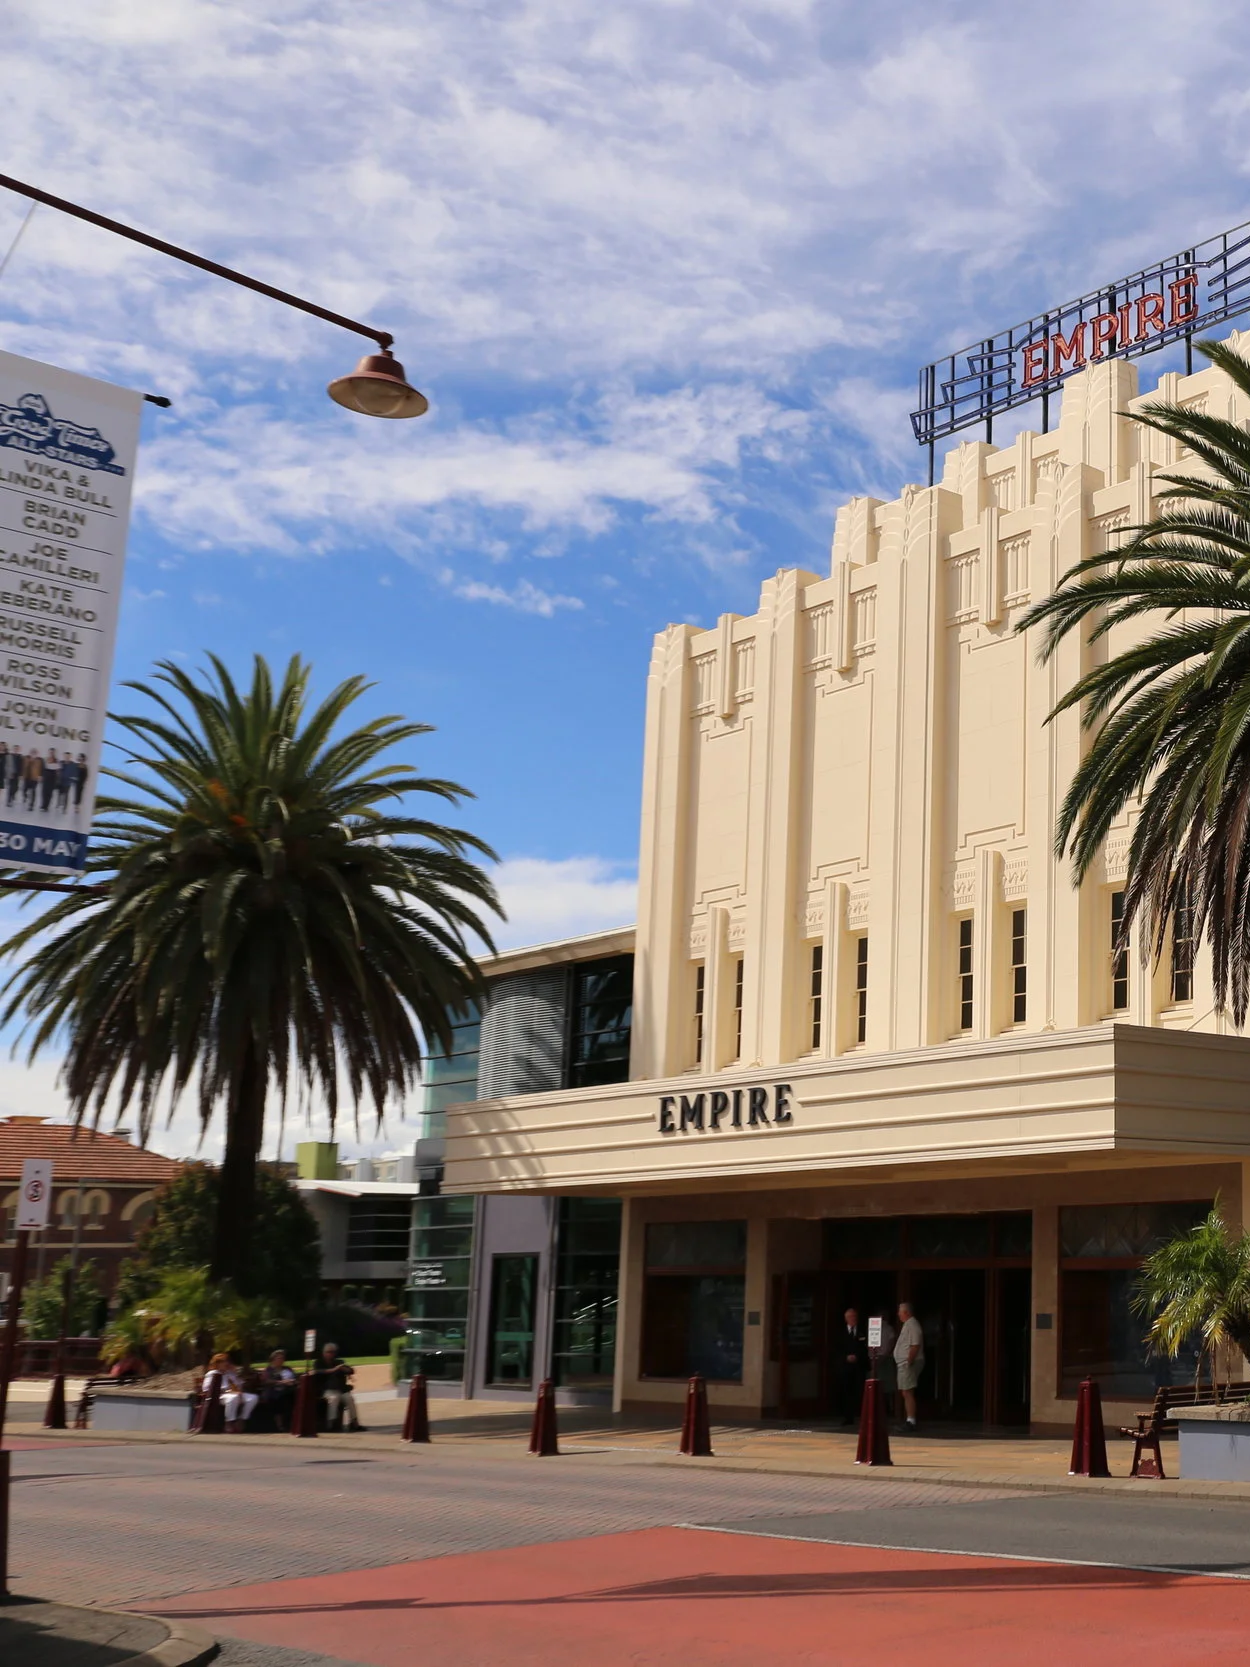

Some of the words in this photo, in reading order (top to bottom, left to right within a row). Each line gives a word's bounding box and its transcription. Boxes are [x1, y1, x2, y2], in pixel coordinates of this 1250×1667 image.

[1021, 273, 1199, 388] EMPIRE
[24, 459, 72, 483] VIKA
[77, 474, 90, 488] &
[0, 468, 58, 495] LINDA
[64, 485, 113, 509] BULL
[24, 499, 86, 526] BRIAN
[23, 515, 79, 539] CADD
[28, 542, 69, 561] JOE
[20, 579, 75, 603] KATE
[7, 658, 61, 681] ROSS
[1, 700, 57, 720] JOHN
[19, 717, 91, 743] YOUNG
[33, 837, 82, 858] MAY
[657, 1084, 794, 1133] EMPIRE
